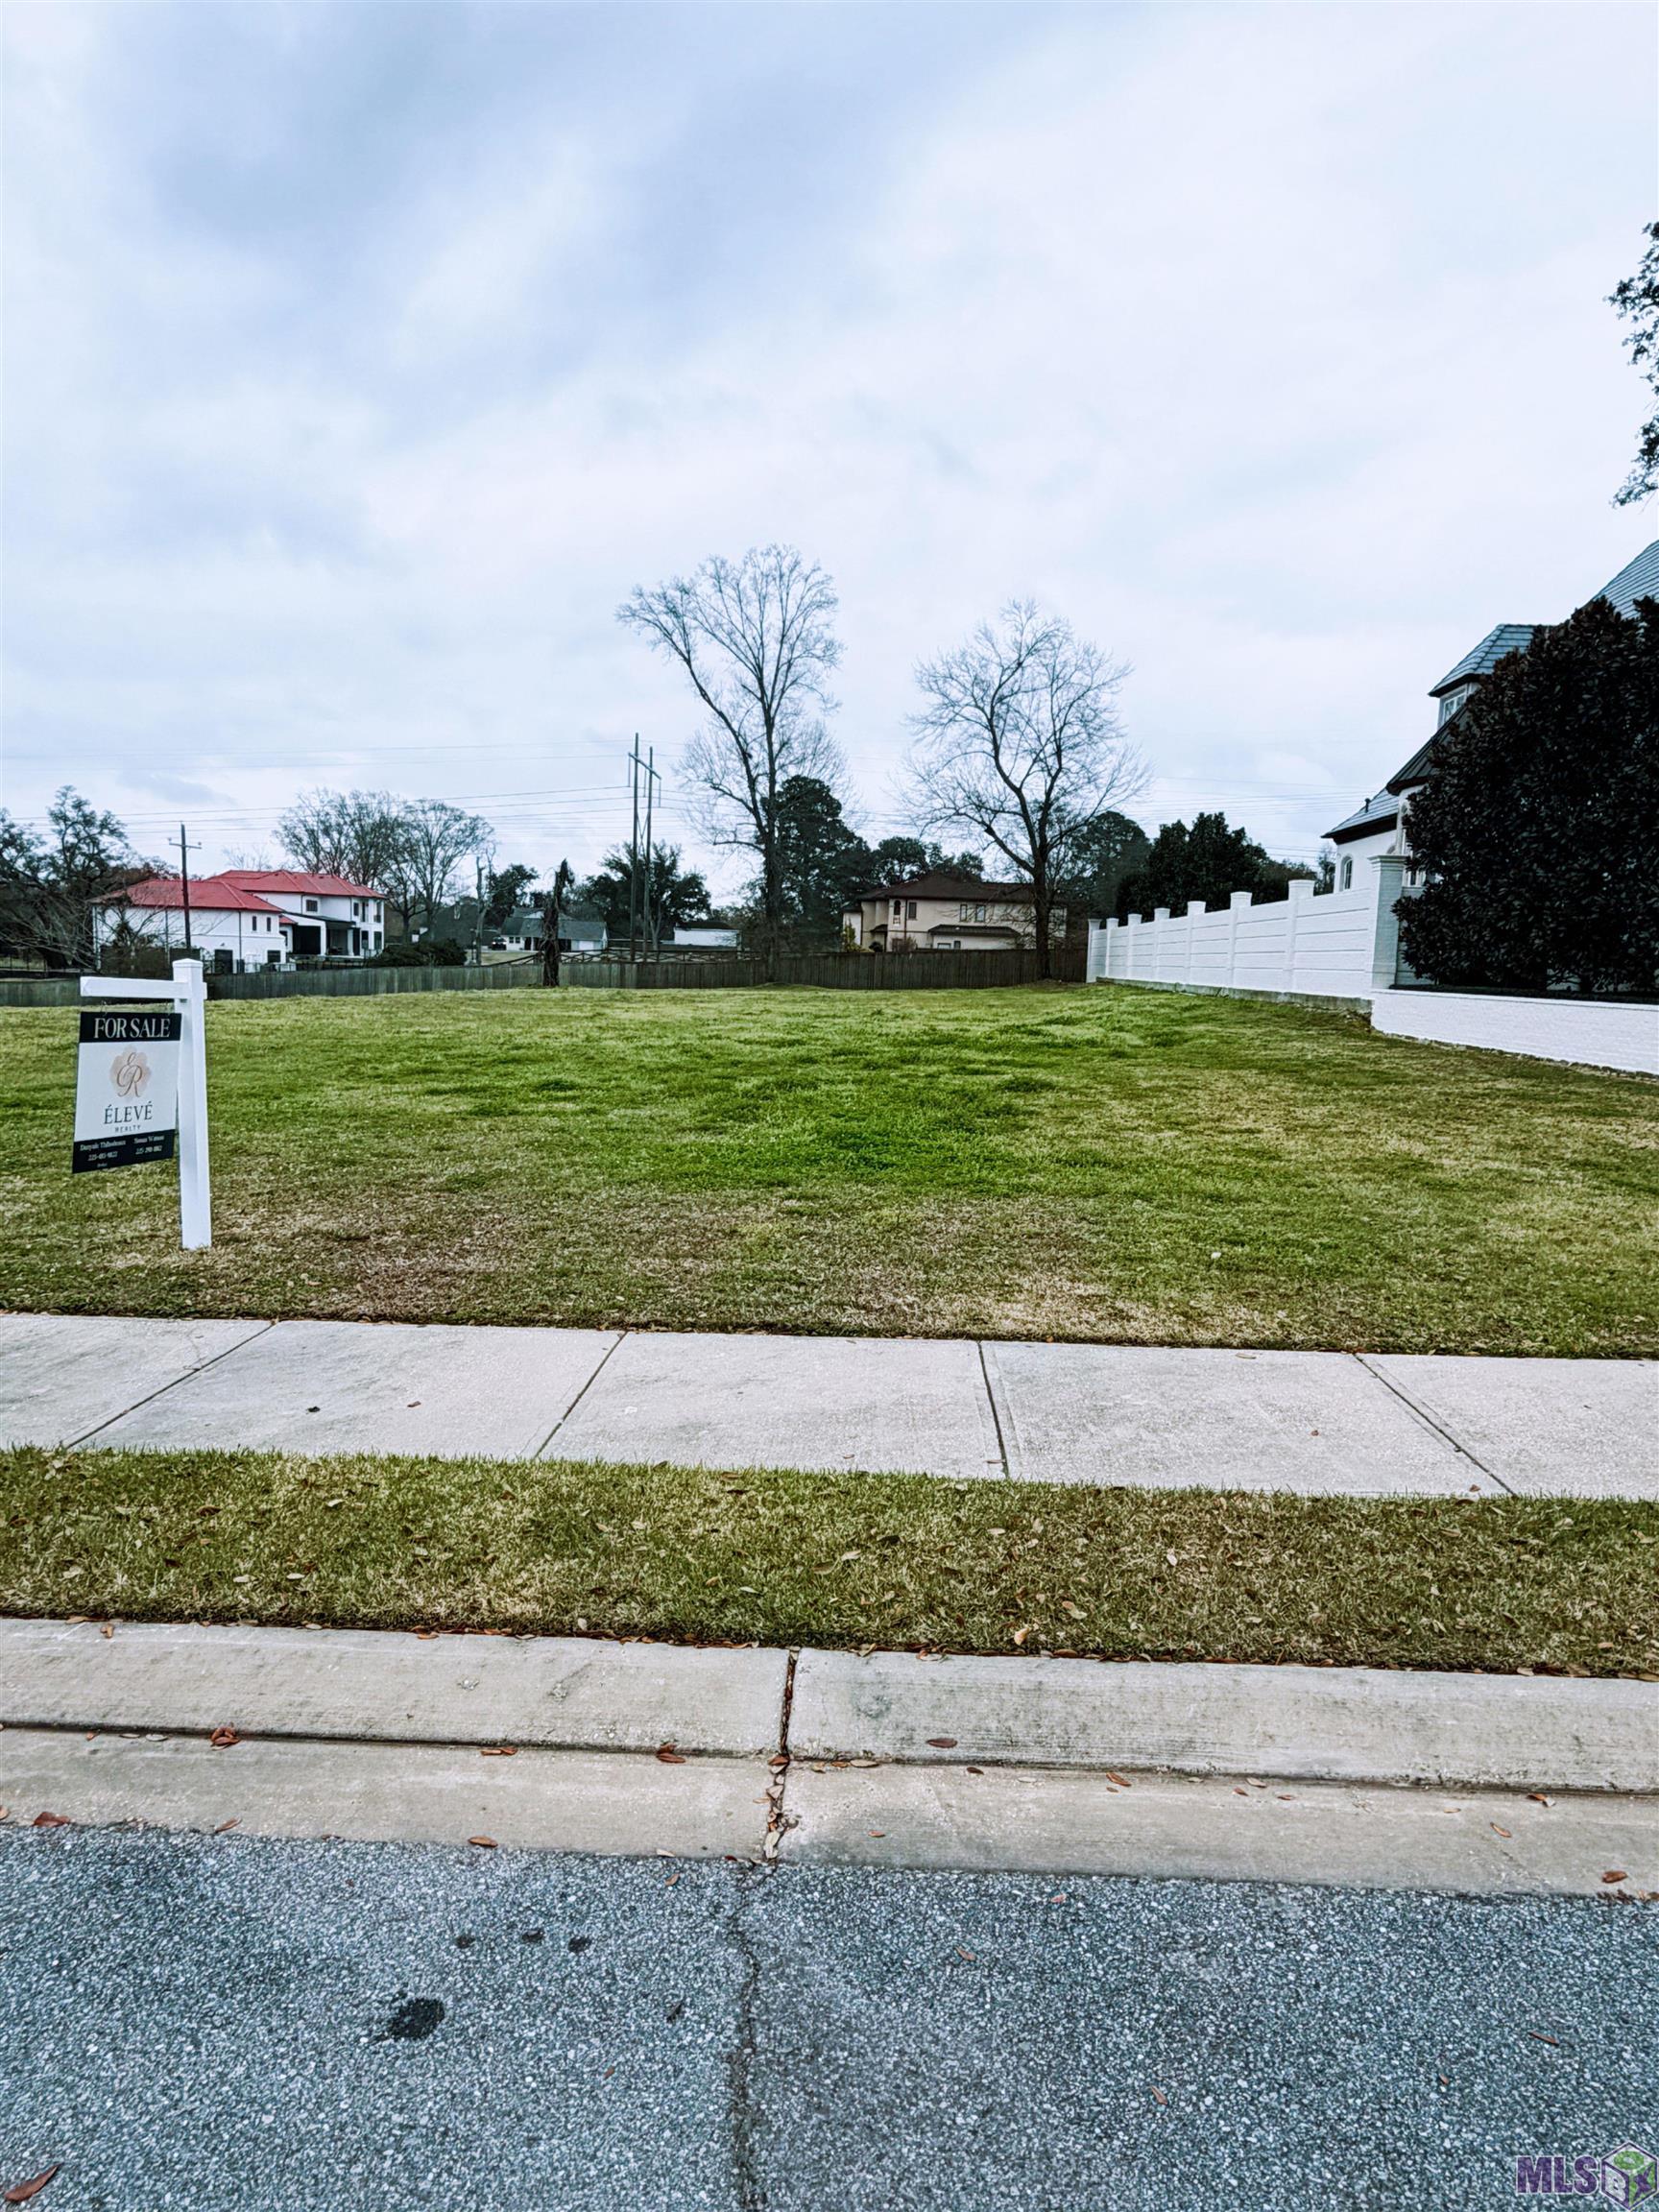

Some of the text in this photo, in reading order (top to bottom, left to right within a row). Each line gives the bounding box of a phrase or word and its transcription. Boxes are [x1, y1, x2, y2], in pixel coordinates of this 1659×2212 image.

[94, 1018, 170, 1038] FOR SALE
[104, 1100, 153, 1124] ÉLEVÉ
